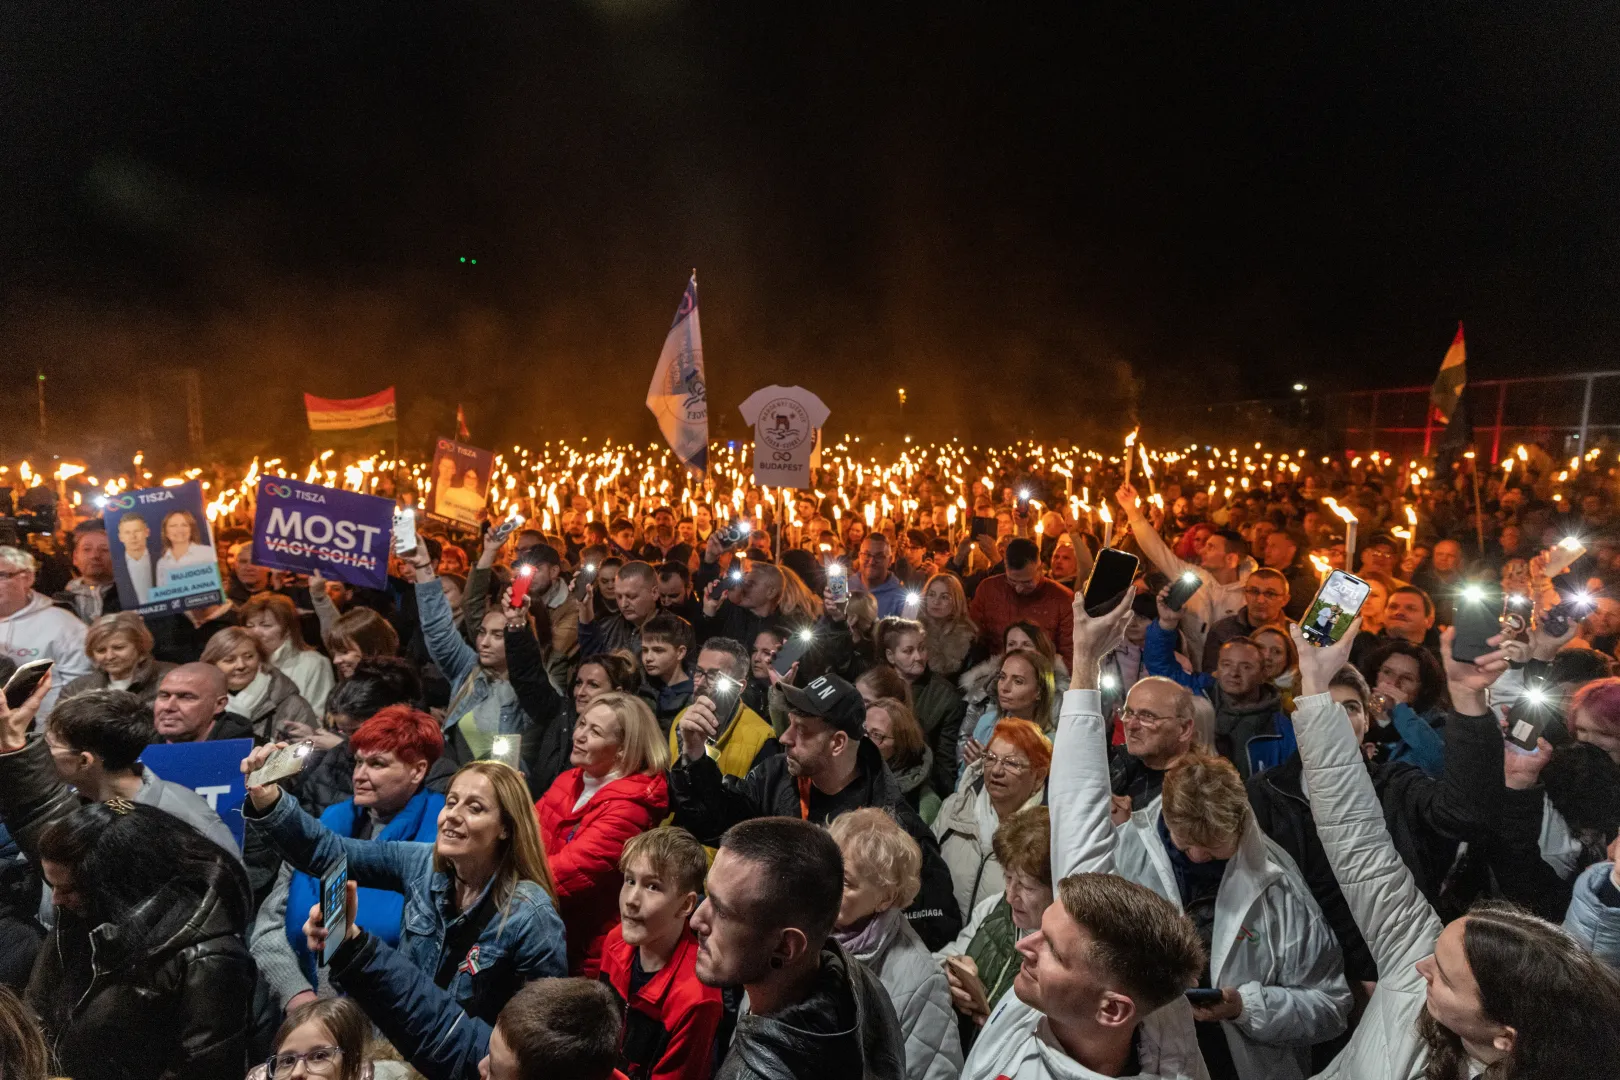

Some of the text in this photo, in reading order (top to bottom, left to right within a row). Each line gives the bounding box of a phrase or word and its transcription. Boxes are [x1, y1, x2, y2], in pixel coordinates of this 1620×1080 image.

[457, 446, 477, 458] TISZA
[760, 461, 803, 472] BUDAPEST
[138, 490, 174, 504] TISZA
[295, 489, 326, 504] TISZA
[265, 507, 381, 554] MOST
[265, 536, 377, 570] VAGY SOHA!
[191, 580, 216, 591] ANNA
[903, 908, 943, 920] ALENCIAGA
